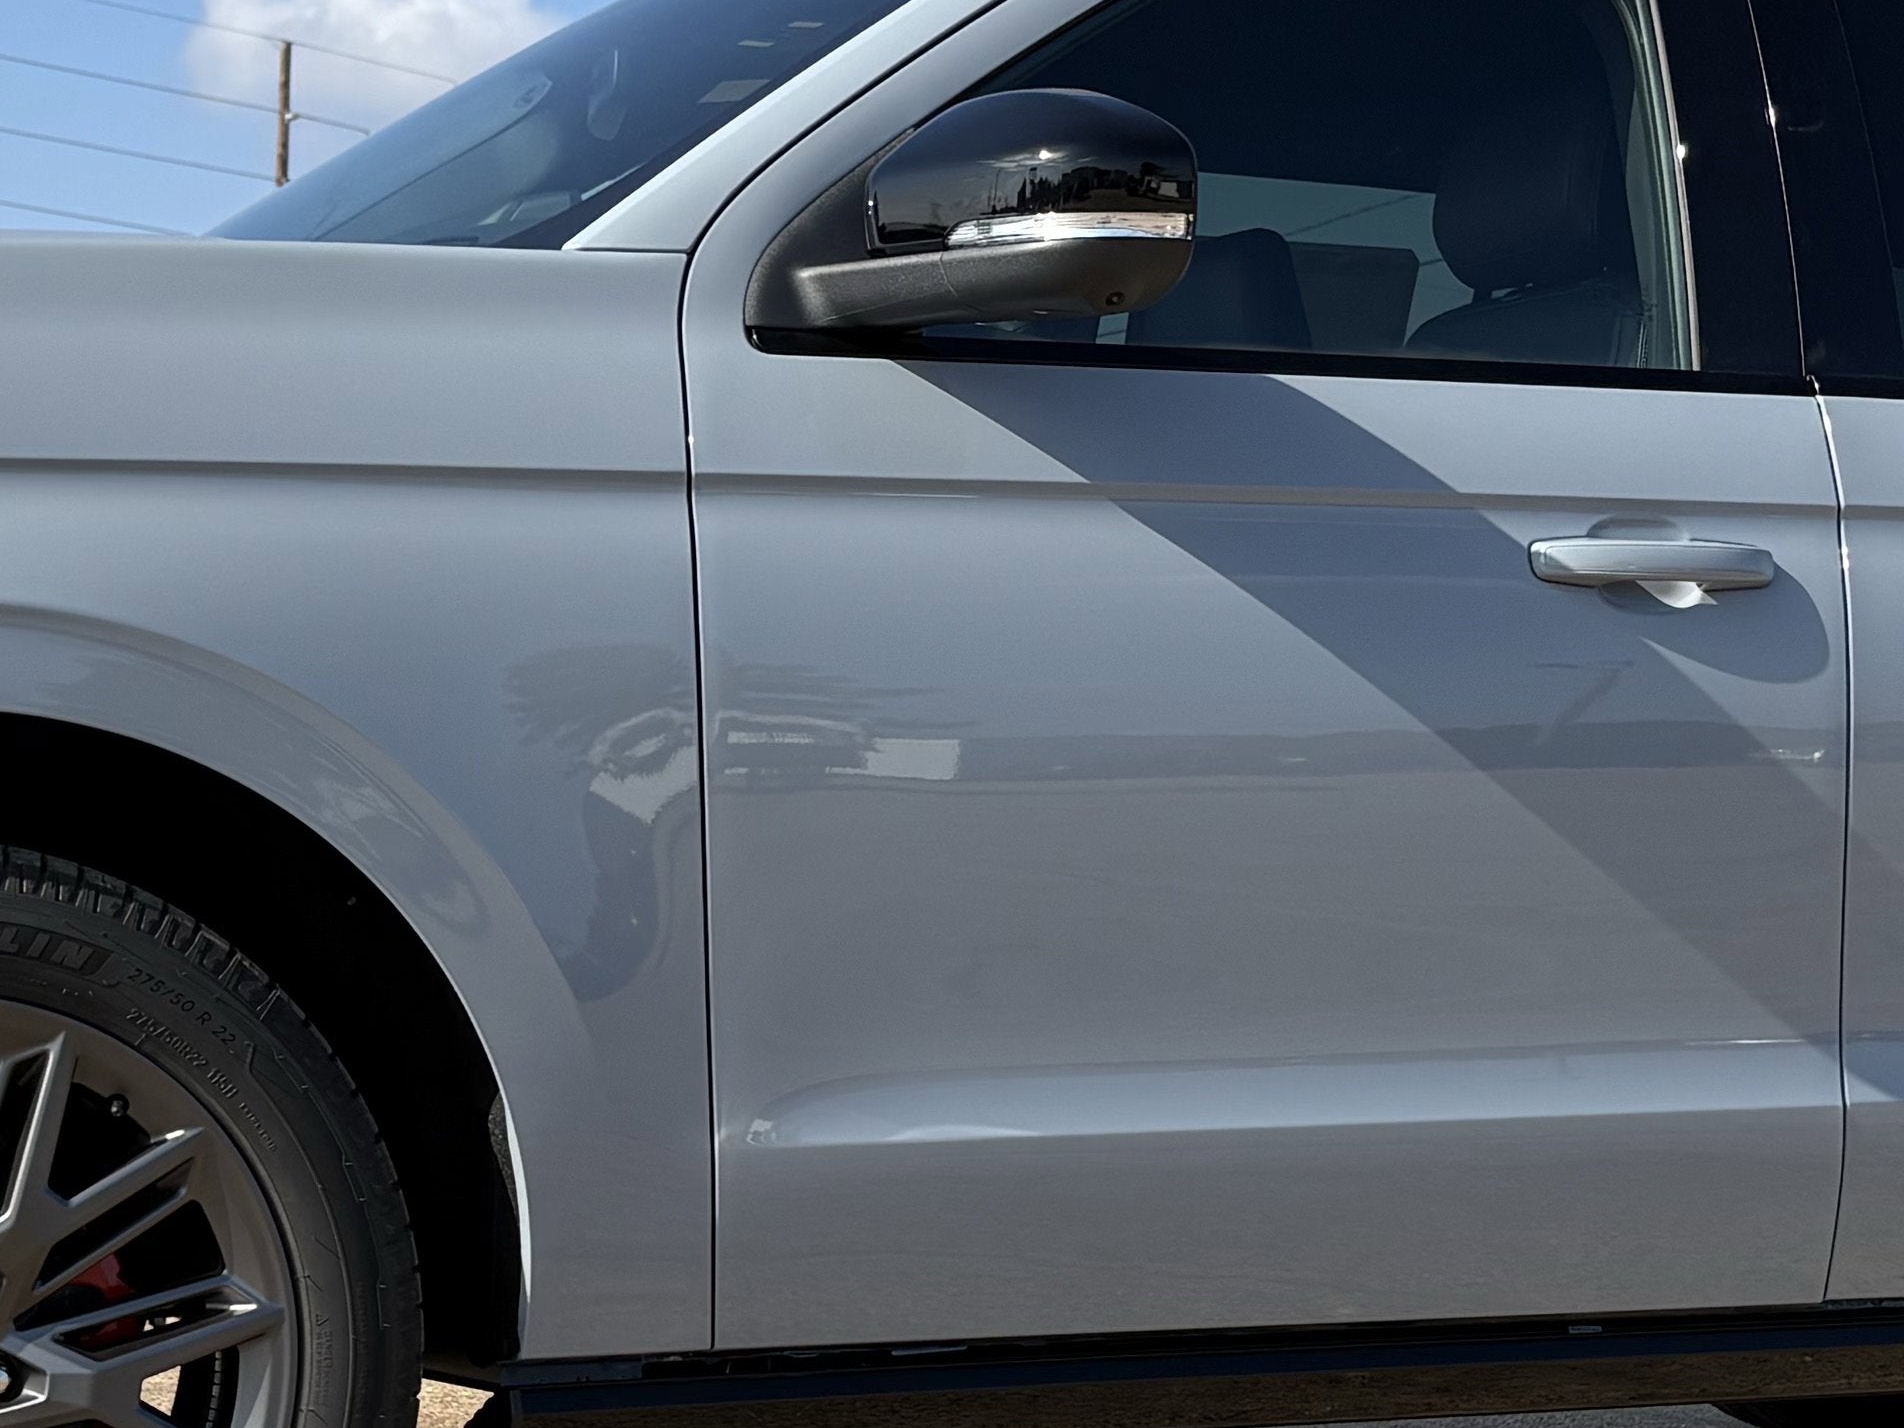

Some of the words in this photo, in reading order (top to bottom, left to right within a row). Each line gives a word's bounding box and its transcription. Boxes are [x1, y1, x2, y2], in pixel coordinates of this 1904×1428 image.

[126, 967, 196, 1013] 275/50
[196, 1011, 212, 1026] R
[211, 1025, 237, 1049] 22
